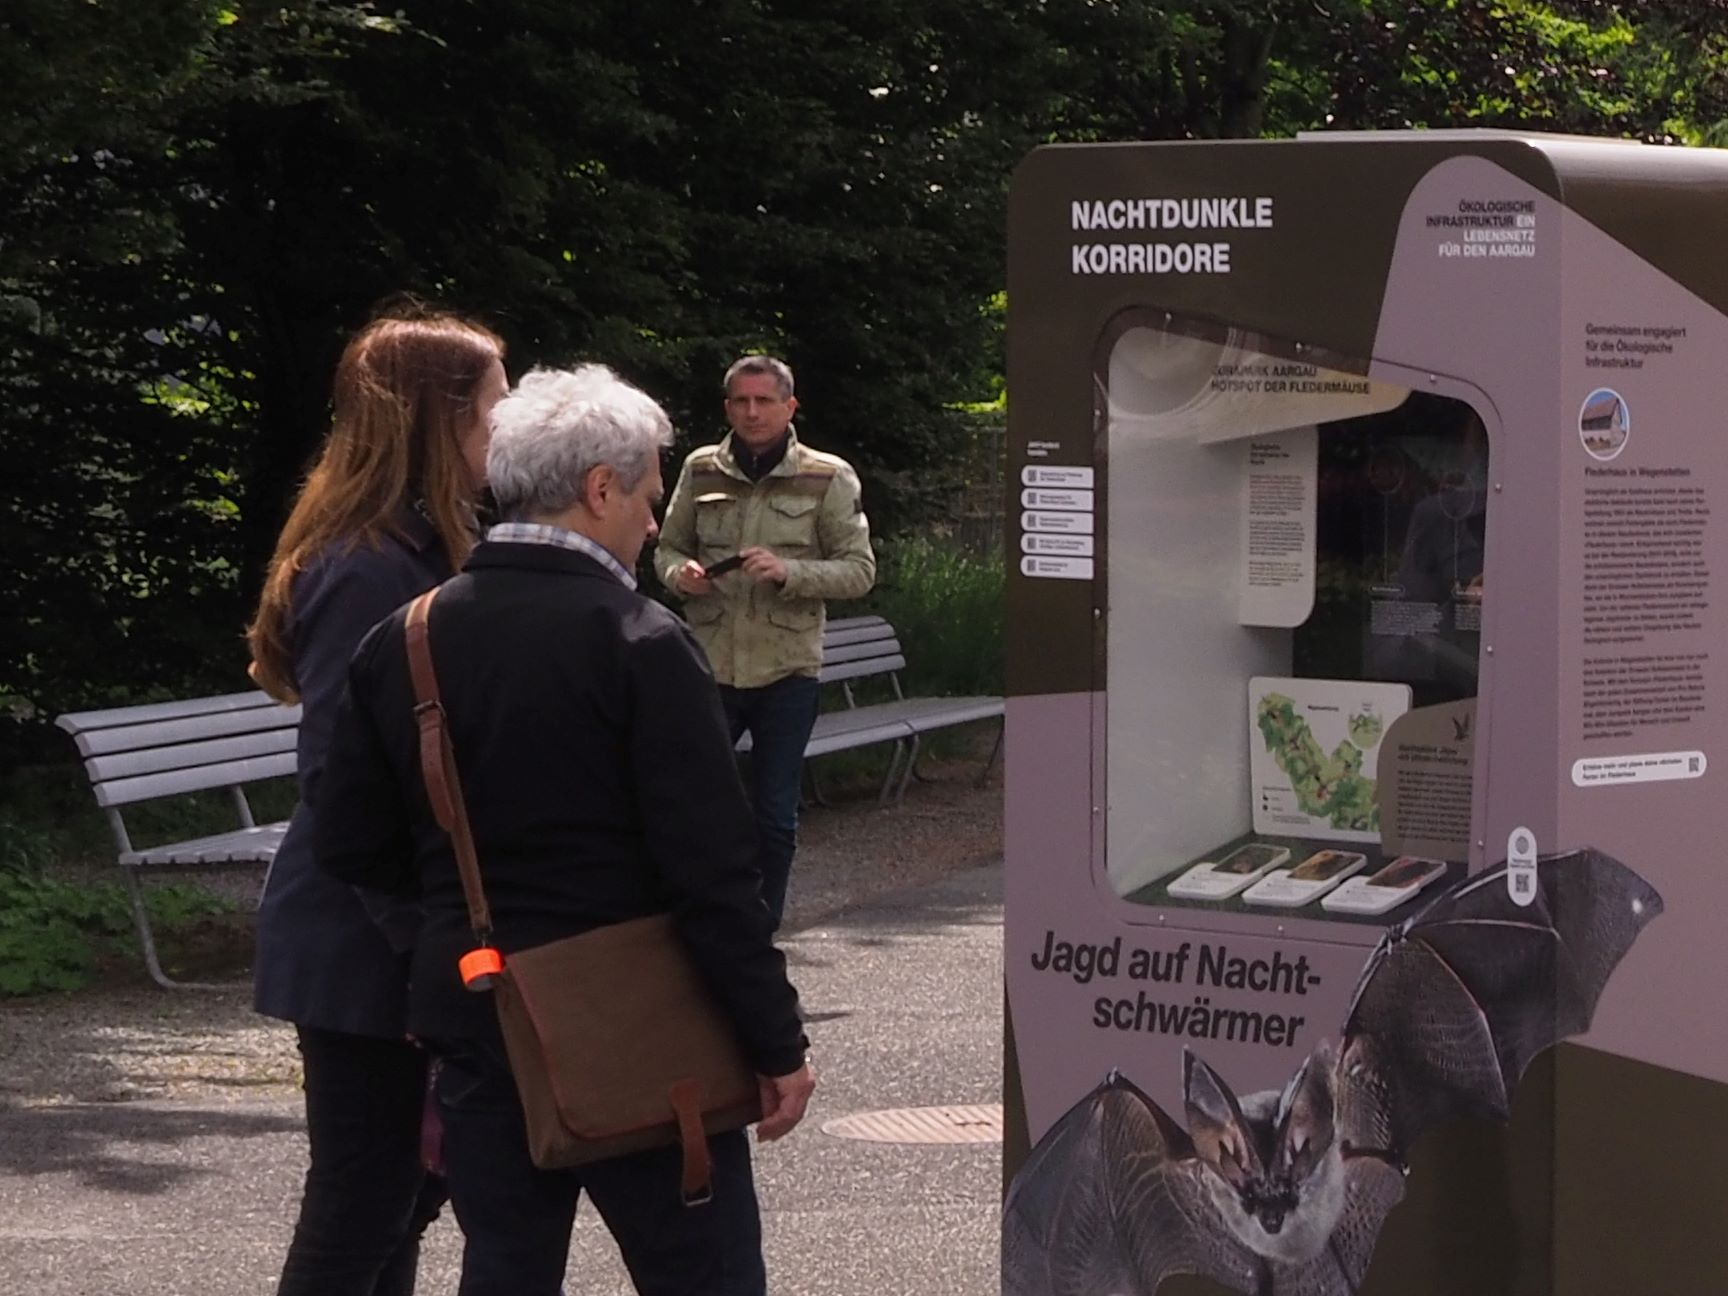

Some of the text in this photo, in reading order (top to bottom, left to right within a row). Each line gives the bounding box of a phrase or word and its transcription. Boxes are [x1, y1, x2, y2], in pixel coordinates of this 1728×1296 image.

[1459, 199, 1535, 212] ÖKOLOGISCHE
[1071, 198, 1273, 230] NACHTDUNKLE
[1426, 215, 1535, 227] INFRASTRUKTUR EIN
[1464, 230, 1535, 242] LEBENSNETZ
[1439, 242, 1535, 256] FÜR DEN AARGAU
[1072, 243, 1231, 274] KORRIDORE
[1586, 324, 1686, 338] Gemeinsam engagiert
[1586, 339, 1672, 354] für die Ökologische
[1586, 357, 1643, 368] Infrastruktur
[1272, 366, 1317, 377] AARGAU
[1265, 381, 1286, 393] DER
[1290, 381, 1370, 394] FLEDERMÄUSE
[1032, 931, 1321, 996] Jagd auf Nacht-
[1093, 992, 1304, 1048] schwärmer
